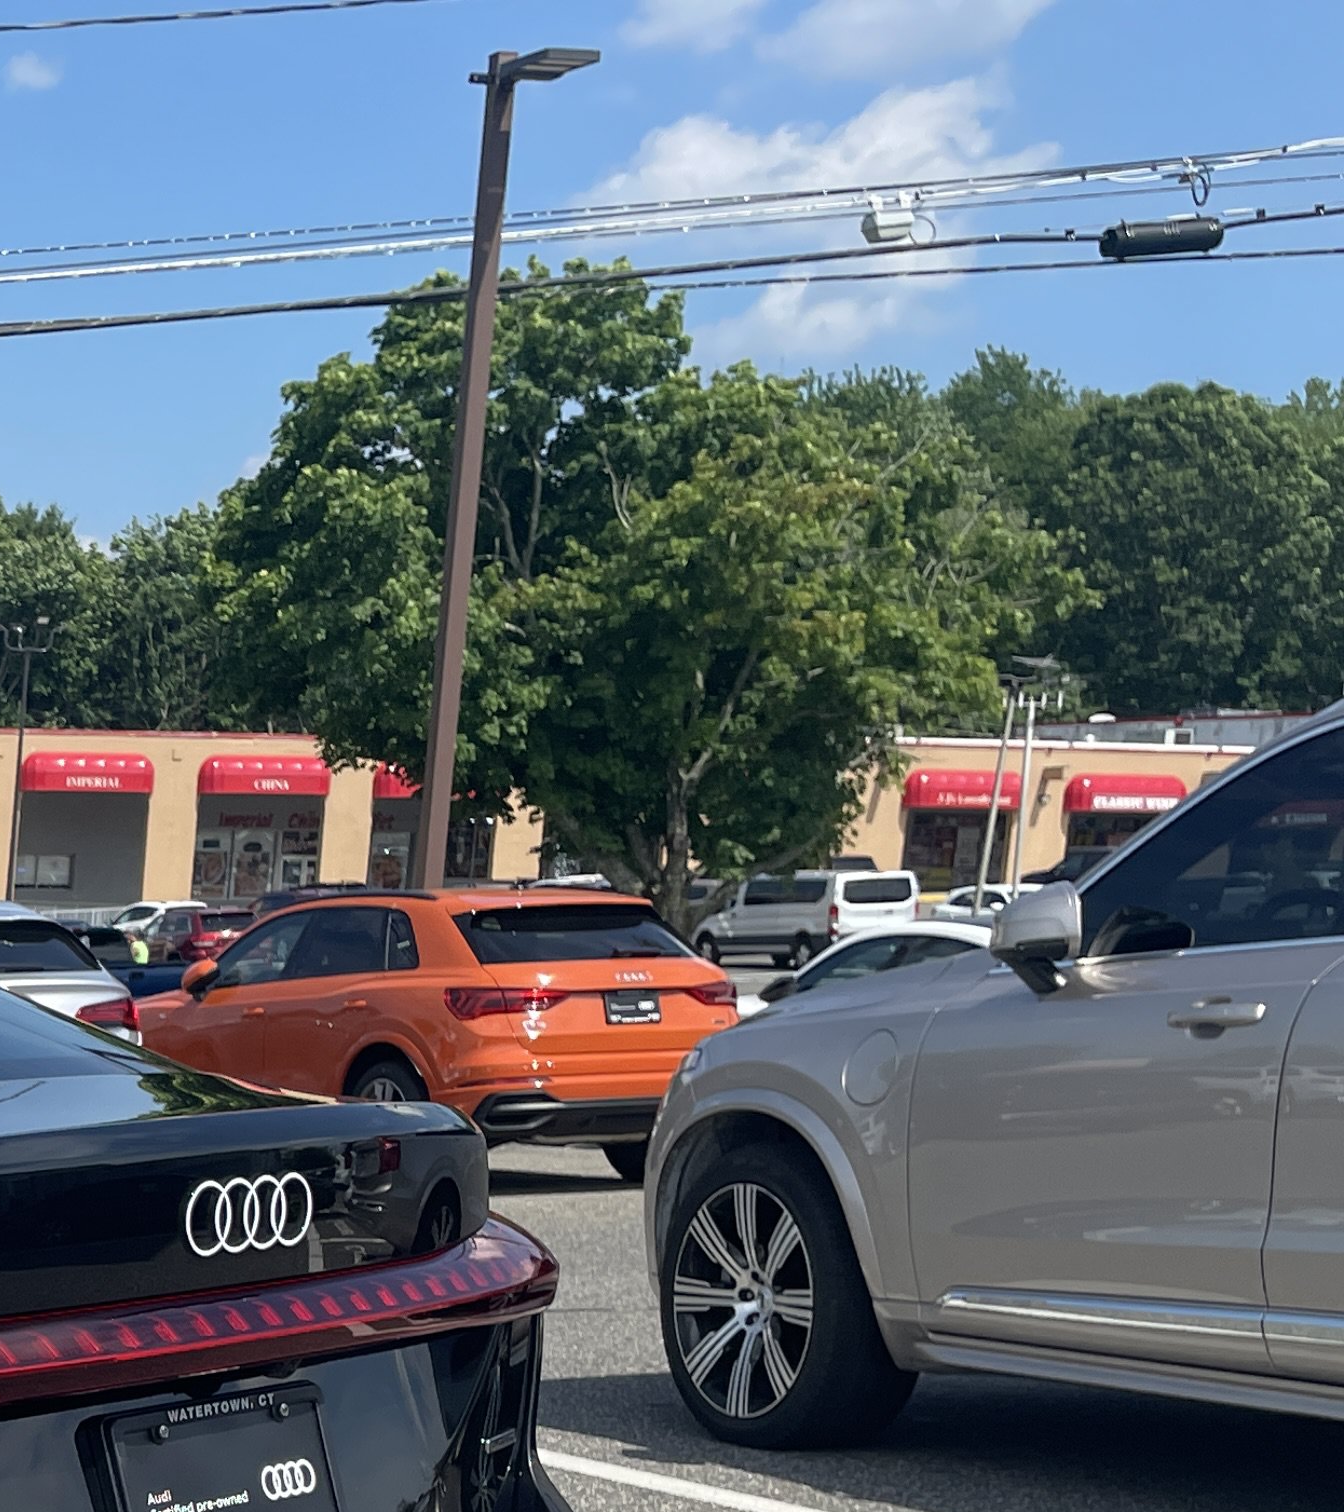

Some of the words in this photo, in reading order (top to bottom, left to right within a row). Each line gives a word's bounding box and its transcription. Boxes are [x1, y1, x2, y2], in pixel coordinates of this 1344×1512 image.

[65, 774, 122, 789] IMPERIAL
[253, 778, 290, 791] CHINA
[167, 1398, 254, 1423] WATERTOWN,
[258, 1393, 274, 1407] CT
[147, 1489, 172, 1506] Audi
